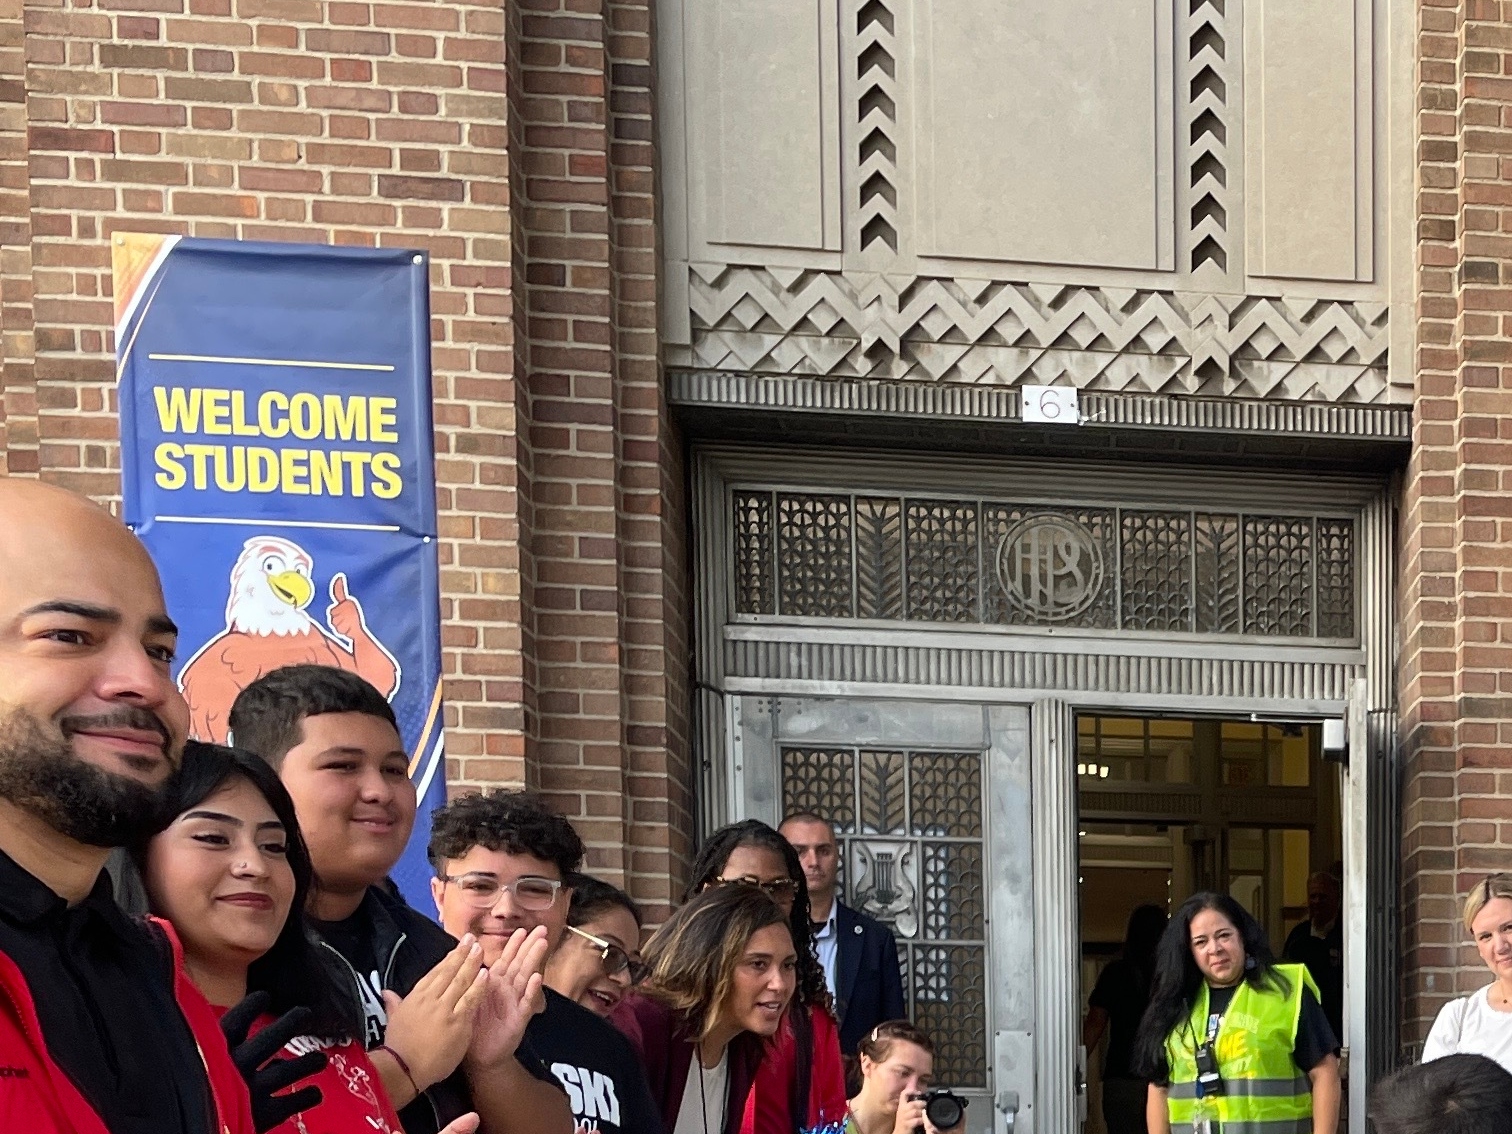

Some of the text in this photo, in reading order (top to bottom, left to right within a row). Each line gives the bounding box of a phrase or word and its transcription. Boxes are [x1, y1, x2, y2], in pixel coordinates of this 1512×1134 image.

[154, 386, 399, 443] WELCOME
[1040, 389, 1061, 419] 6
[154, 442, 403, 500] STUDENTS
